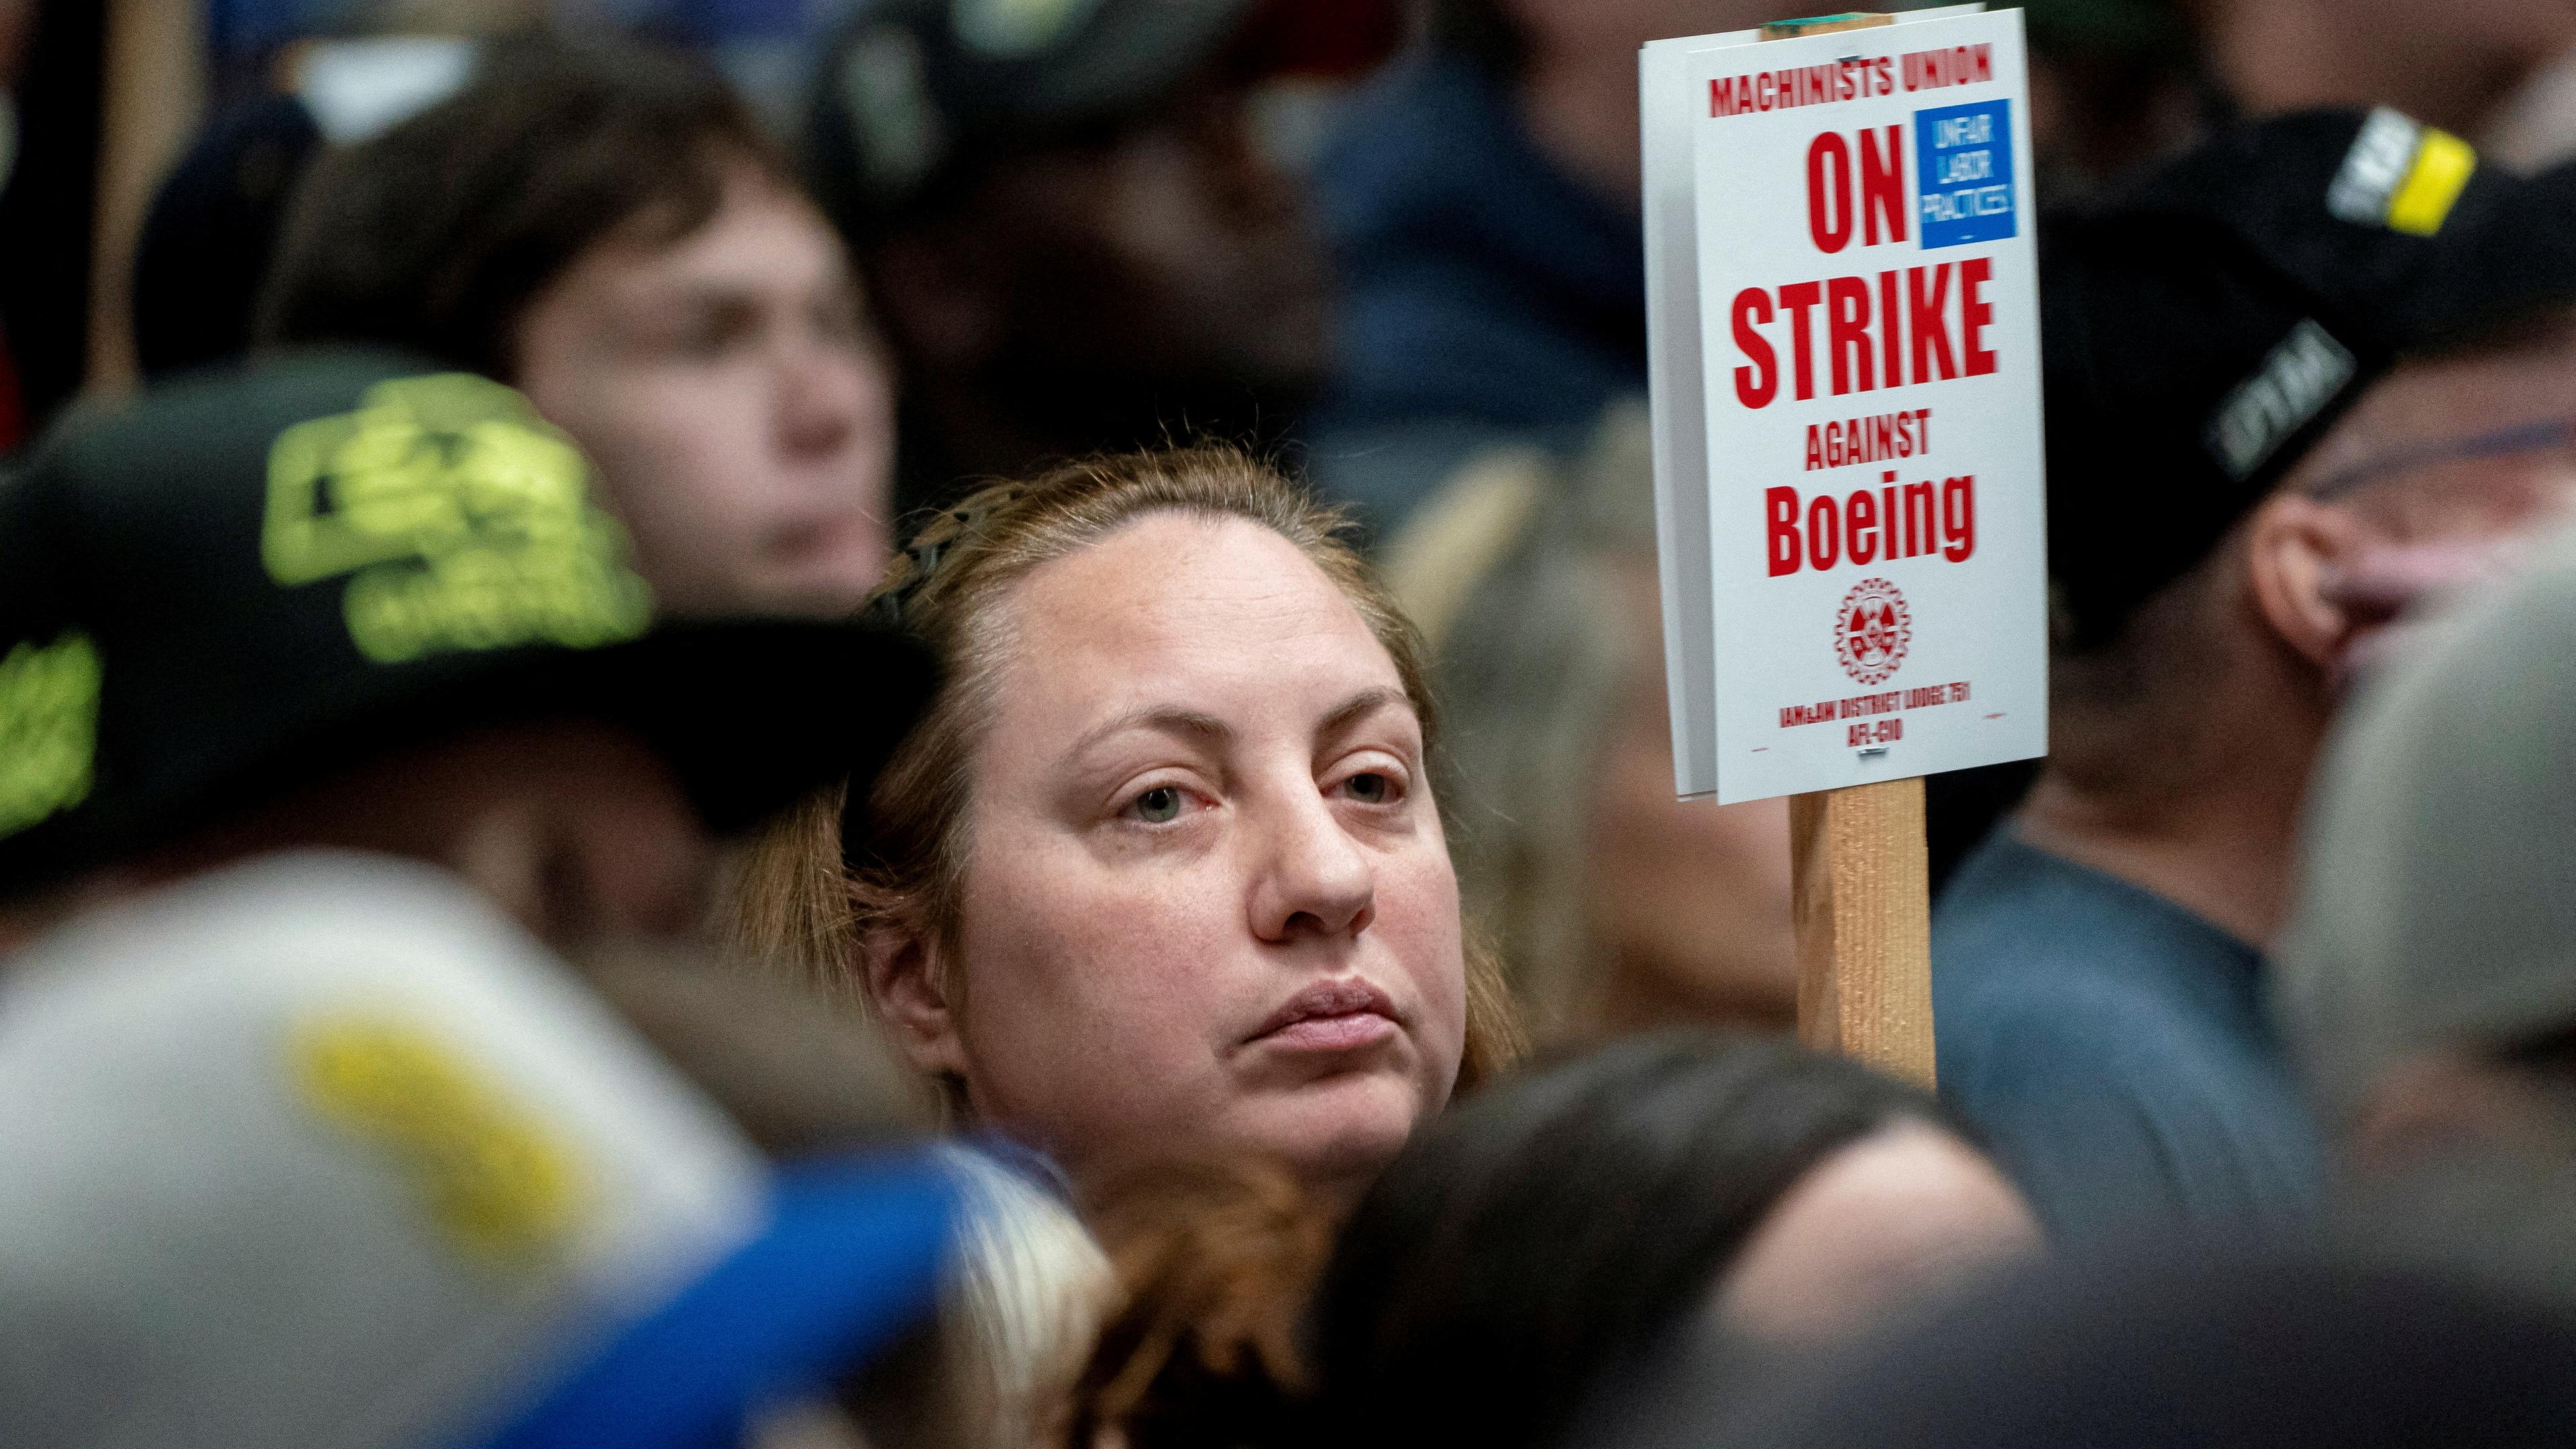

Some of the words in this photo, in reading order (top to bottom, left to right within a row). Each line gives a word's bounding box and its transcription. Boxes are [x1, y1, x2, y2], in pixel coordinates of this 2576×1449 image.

[1709, 56, 1893, 117] MACHINISTS
[1902, 42, 1992, 92] UNION
[1931, 113, 1993, 149] UNFAIR
[1807, 124, 1908, 254] ON
[1936, 150, 1993, 184] LABOR
[1921, 184, 2012, 224] PRACTICES
[1731, 257, 1998, 409] STRIKE
[1805, 409, 1931, 472] AGAINST
[1764, 471, 1976, 578] Boeing
[1841, 690, 1900, 719] DISTRICT
[1904, 684, 1947, 710] LODGE
[1949, 680, 1971, 702] 751
[1847, 718, 1902, 747] AFL-CIO
